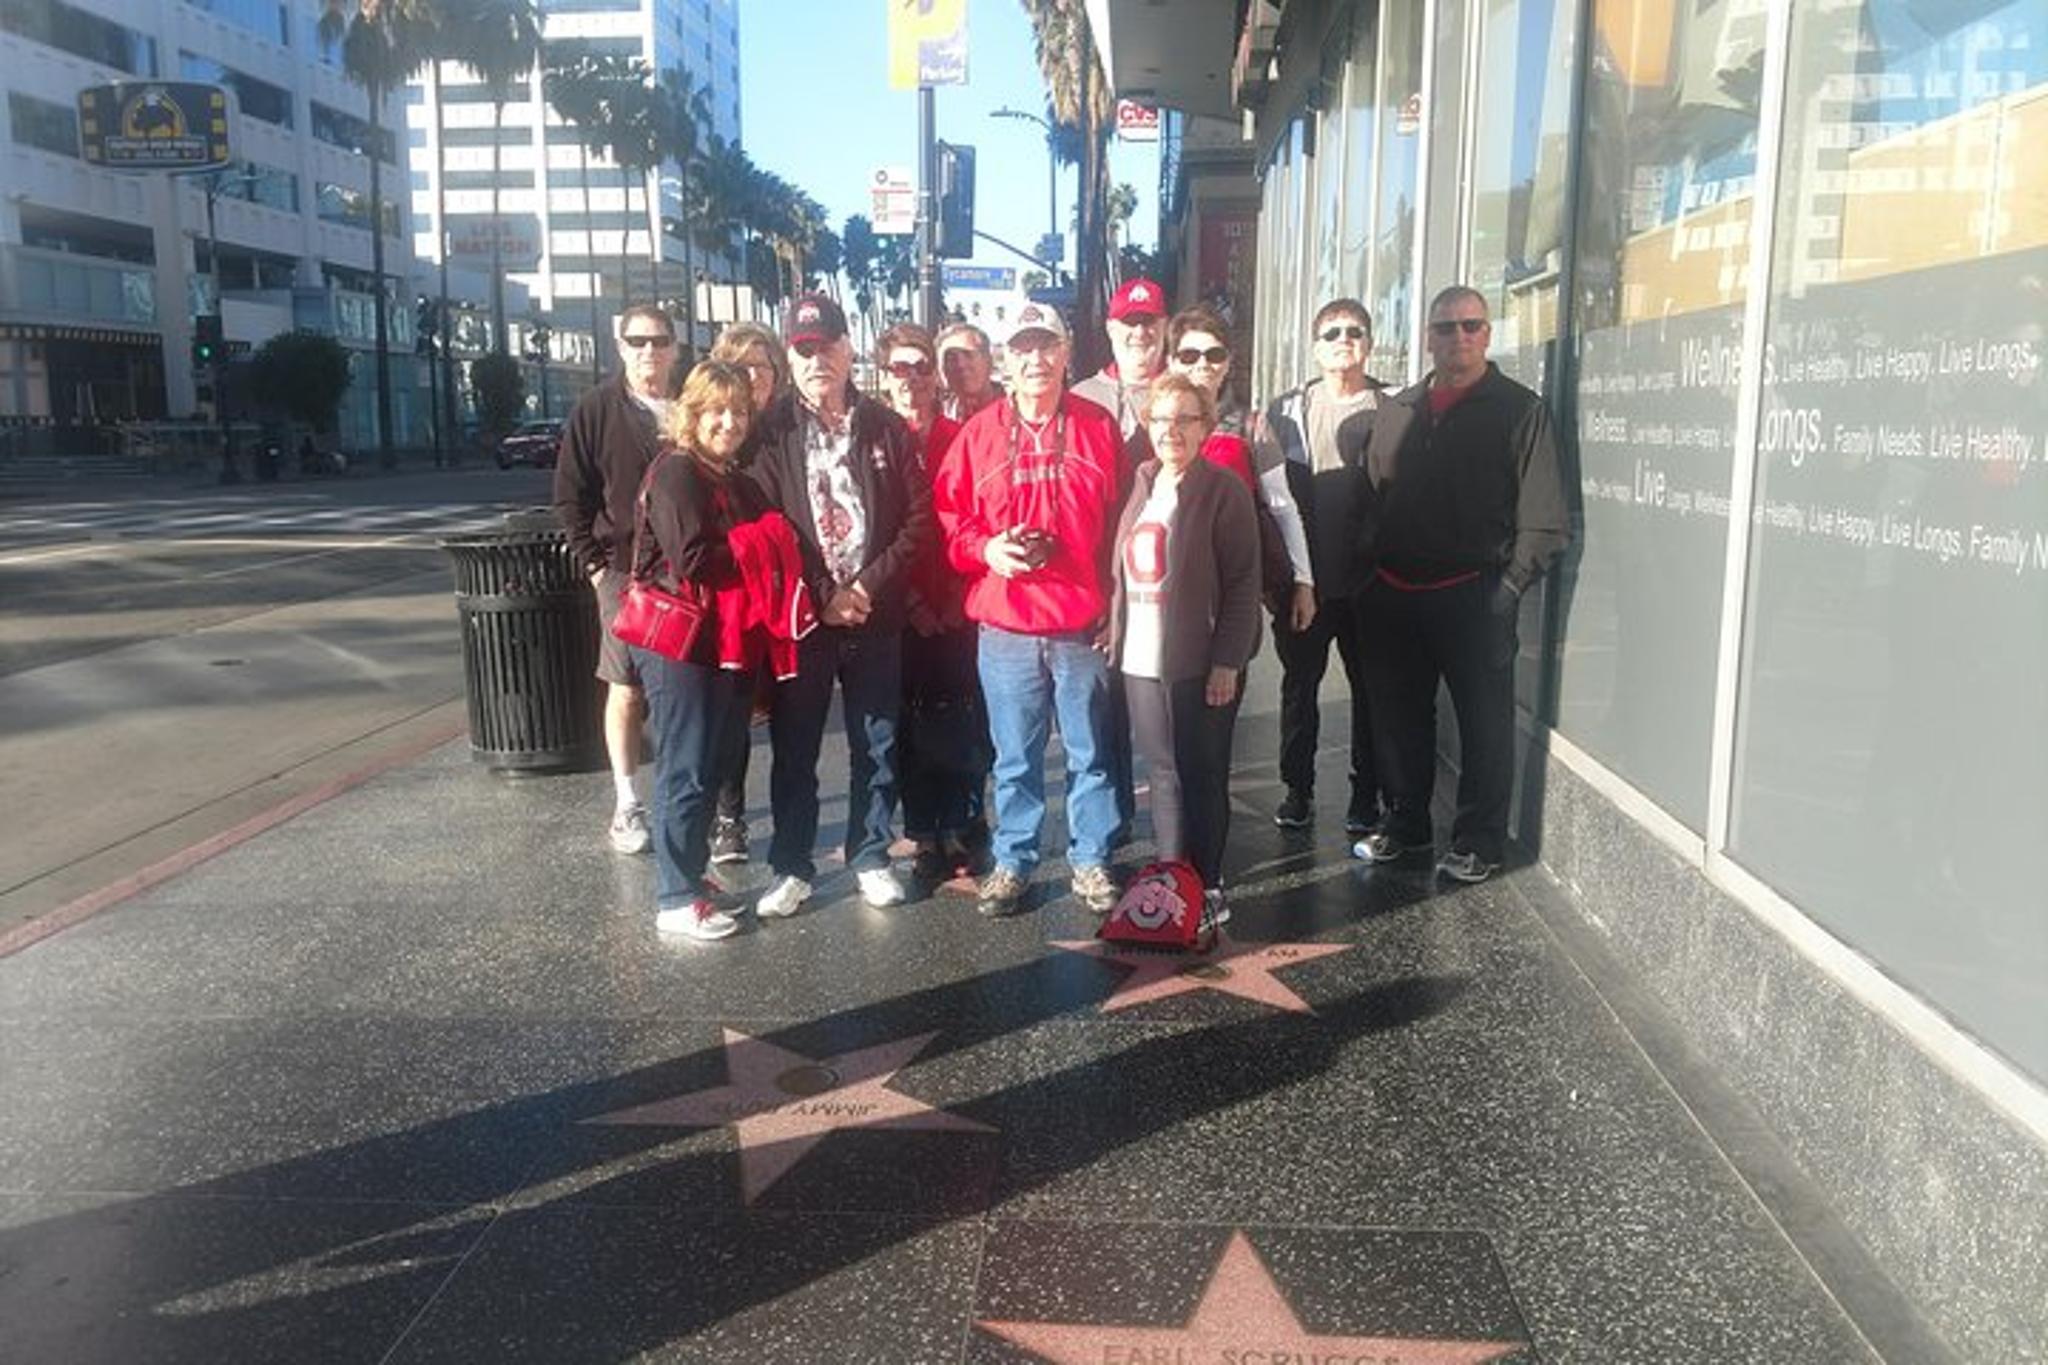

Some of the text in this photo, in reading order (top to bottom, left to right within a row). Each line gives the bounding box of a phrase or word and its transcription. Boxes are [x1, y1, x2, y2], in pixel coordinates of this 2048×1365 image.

[1855, 349, 1882, 379] Live
[1884, 346, 1934, 384] Happy.
[1939, 339, 1973, 374] Live
[1833, 424, 1873, 463] Family
[1930, 423, 1962, 459] Live
[1965, 425, 2037, 471] Healthy.
[1634, 458, 1665, 507] Live
[1808, 503, 1833, 535] Live
[1882, 512, 1911, 548] Live
[1968, 524, 2030, 576] Family
